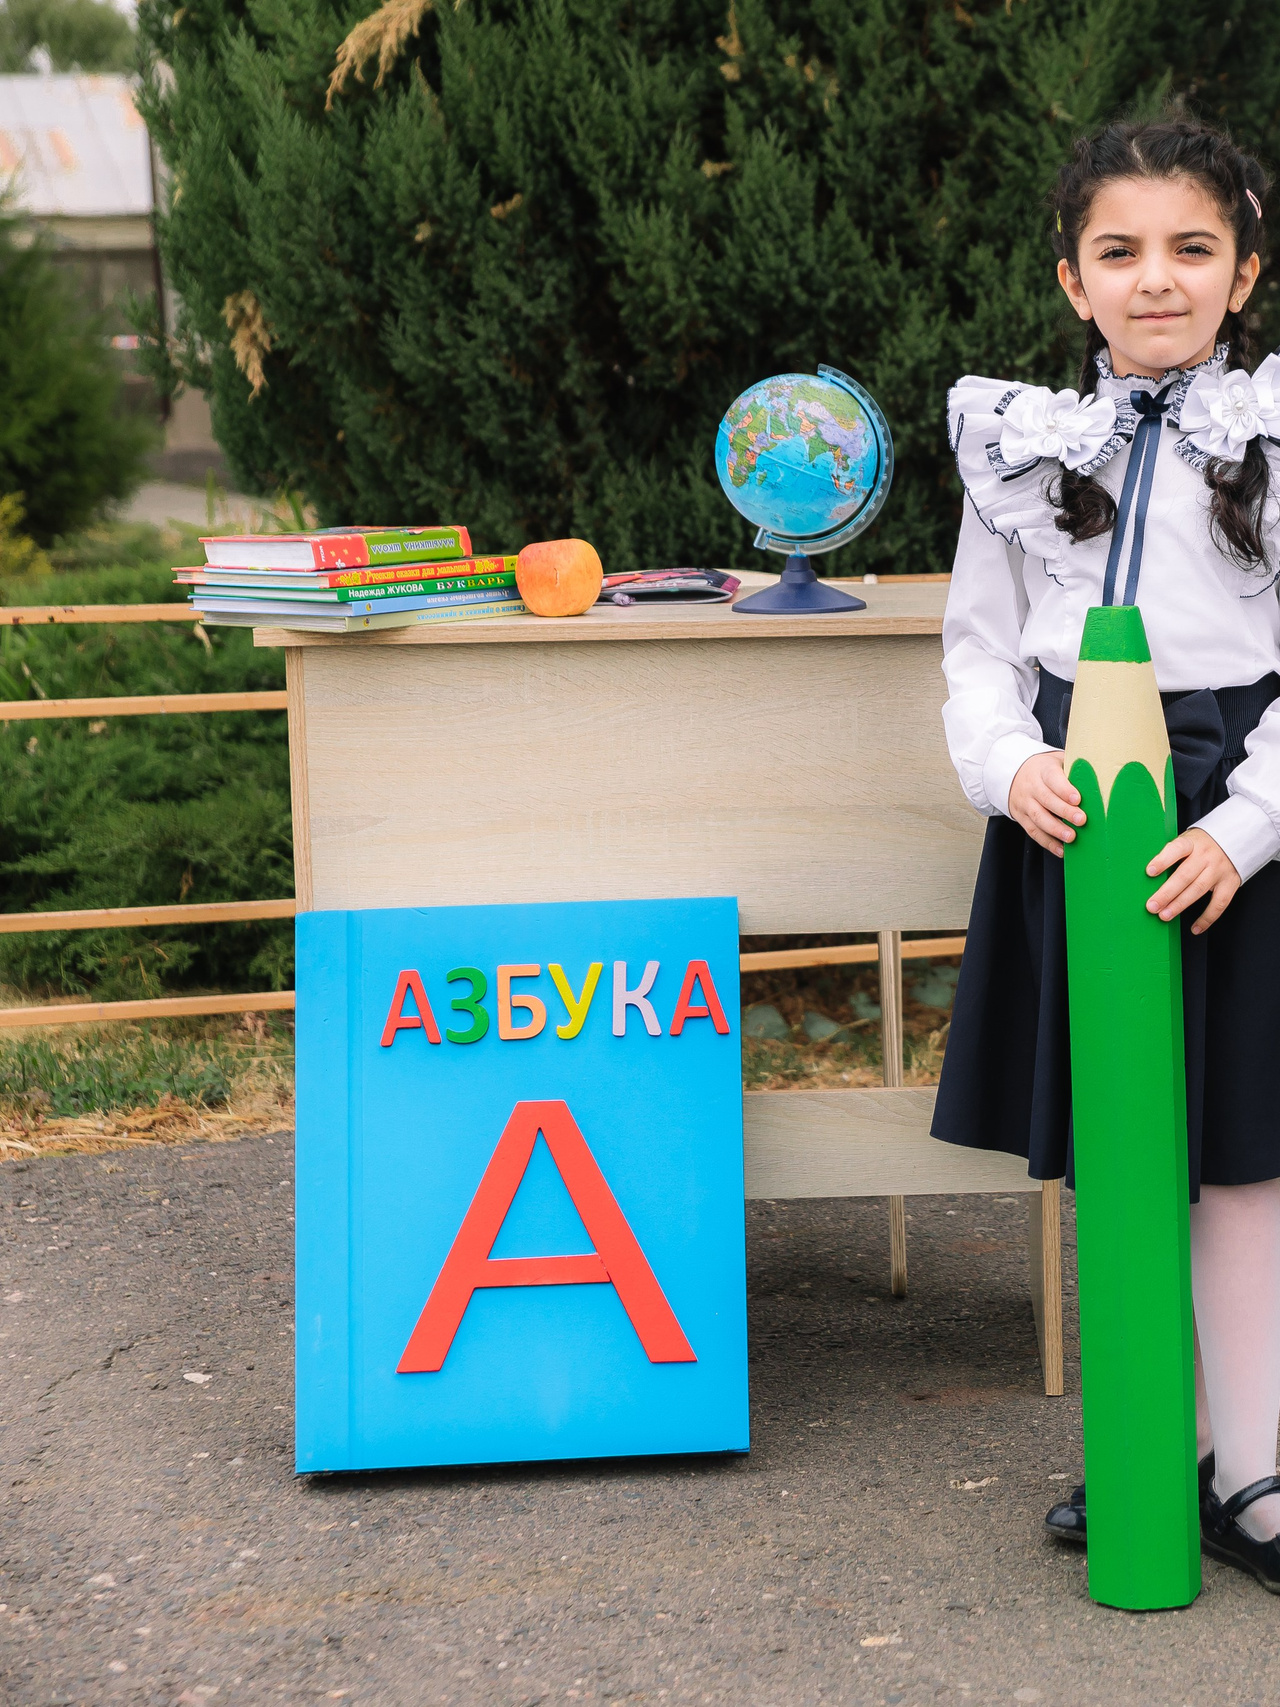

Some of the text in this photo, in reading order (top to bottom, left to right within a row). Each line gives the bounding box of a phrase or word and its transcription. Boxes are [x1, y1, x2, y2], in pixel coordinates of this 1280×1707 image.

[370, 538, 456, 555] МАЛЫШКИНА ШКОЛА
[365, 563, 471, 583] Русские сказки для малышей
[348, 576, 505, 599] Надежда ЖУКОВА БУКВАРЬ
[380, 959, 731, 1047] АЗБУКА
[395, 1099, 698, 1374] А
